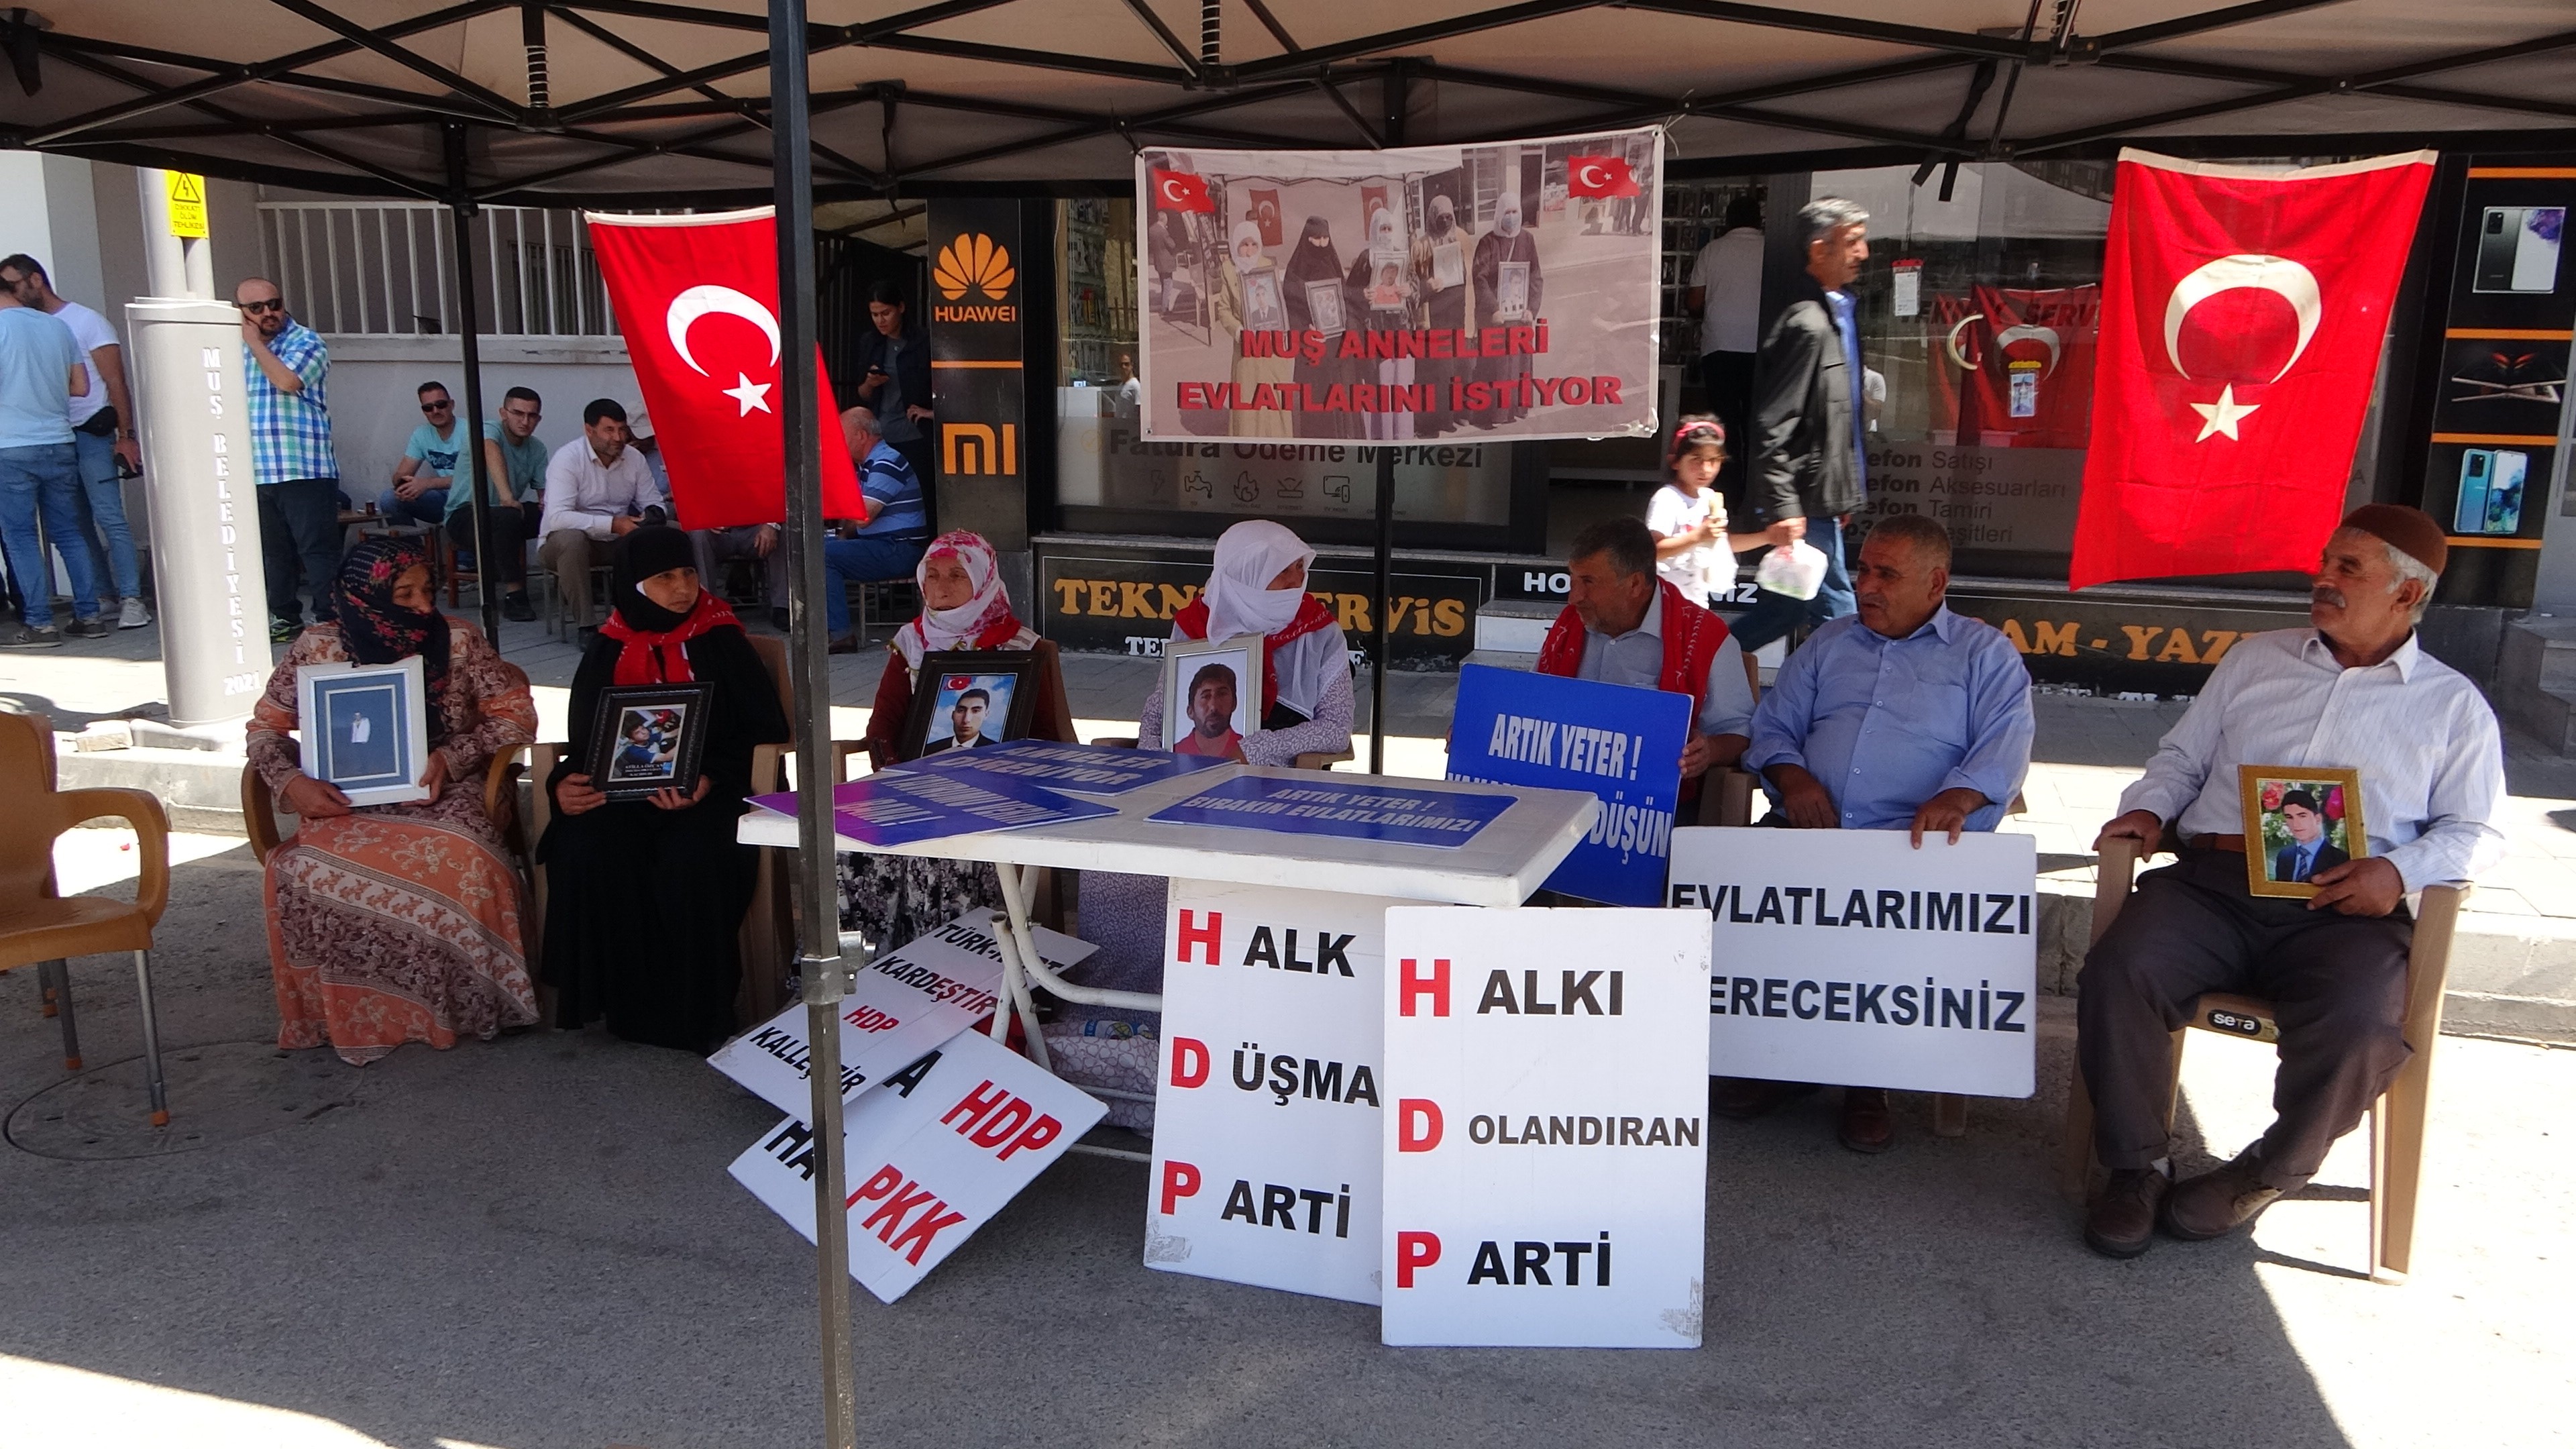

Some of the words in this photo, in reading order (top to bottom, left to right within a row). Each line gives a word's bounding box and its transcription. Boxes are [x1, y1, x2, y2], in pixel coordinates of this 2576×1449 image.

[935, 306, 1016, 322] HUAWEI
[1240, 329, 1328, 367] MUŞ
[1338, 318, 1550, 360] ANNELERİ
[1177, 381, 1436, 414] EVLATLARINI
[1449, 370, 1623, 411] İSTİYOR
[1929, 476, 2066, 498] Aksesuarları
[1931, 450, 1993, 475] Satışı
[202, 347, 223, 420] MUŞ
[213, 433, 246, 665] BELEDİYESİ
[1928, 499, 1992, 519] Tamiri
[223, 671, 262, 696] 2021
[991, 746, 1173, 769] ANNELER
[1488, 713, 1558, 766] ARTIK
[1560, 724, 1628, 778] YETER
[1182, 796, 1284, 816] BIRAKIN
[1285, 805, 1482, 833] EVLATLARIMIZI
[1270, 788, 1350, 806] ARTIK
[1344, 793, 1423, 812] YETER
[1589, 790, 1672, 865] DÜŞÜN
[1672, 883, 2031, 935] EVLATLARIMIZI
[1177, 908, 1222, 967] H
[1242, 925, 1357, 978] ALK
[873, 955, 1000, 1015] KARDEŞTİR
[1399, 959, 1451, 1018] H
[1477, 969, 1624, 1016] ALKI
[1709, 976, 2027, 1033] ERECEKSİNİZ
[843, 1005, 900, 1034] HDP
[1170, 1036, 1211, 1089] D
[939, 1079, 1063, 1162] HDP
[1399, 1098, 1444, 1153] D
[1468, 1115, 1701, 1147] OLANDIRAN
[846, 1163, 968, 1267] PKK
[1160, 1159, 1201, 1216] P
[1220, 1179, 1351, 1240] ARTİ
[1397, 1230, 1442, 1289] P
[1466, 1230, 1611, 1287] ARTİ
